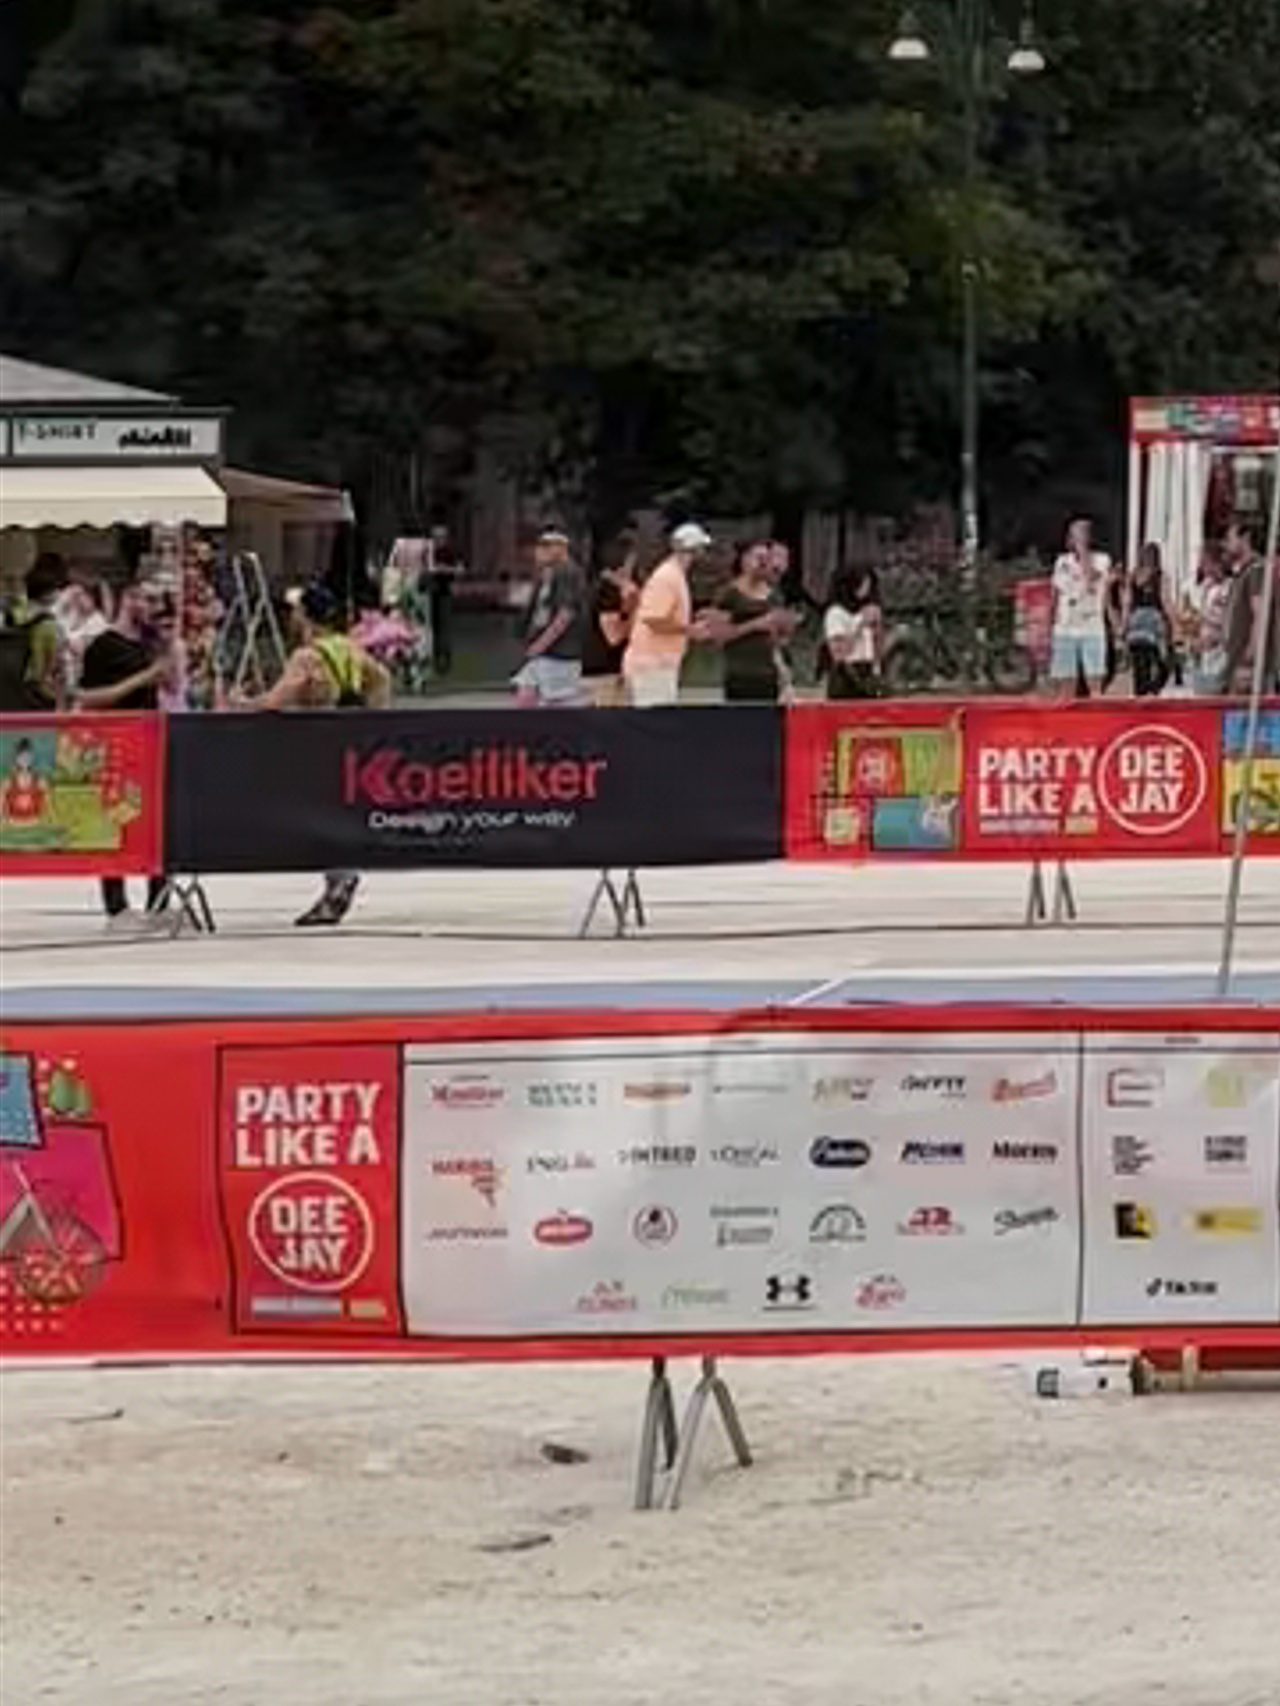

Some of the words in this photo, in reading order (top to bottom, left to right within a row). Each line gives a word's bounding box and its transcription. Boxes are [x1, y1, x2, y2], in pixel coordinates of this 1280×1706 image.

[344, 744, 608, 805] Koelliker
[979, 747, 1096, 778] PARTY
[1119, 745, 1184, 778] DEE
[979, 781, 1062, 815] LIKE
[1071, 782, 1098, 814] A
[1120, 782, 1184, 814] JAY
[236, 1081, 381, 1124] PARTY
[236, 1126, 338, 1166] LIKE
[350, 1124, 381, 1165] A
[269, 1196, 350, 1235] DEE
[278, 1238, 349, 1273] JAY
